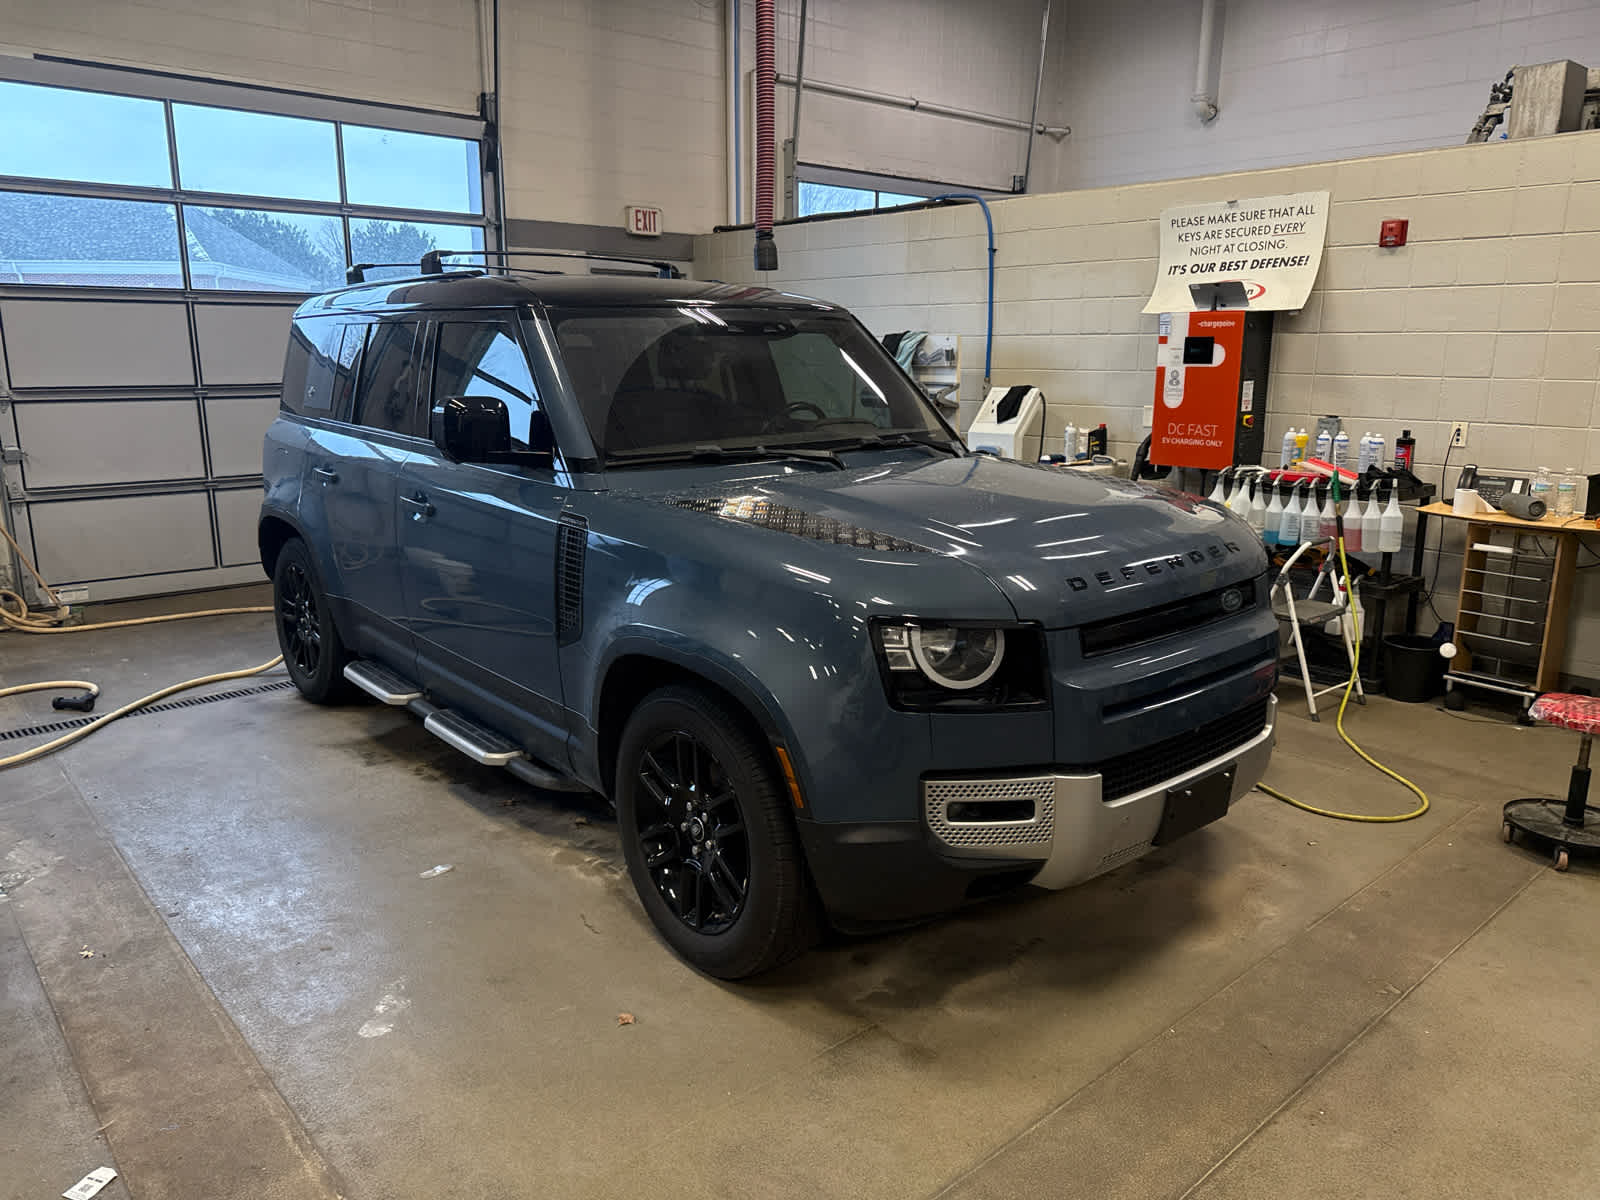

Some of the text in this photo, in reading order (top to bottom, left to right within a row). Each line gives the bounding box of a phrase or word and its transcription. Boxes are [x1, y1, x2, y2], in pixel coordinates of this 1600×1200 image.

[635, 209, 657, 232] EXIT
[1171, 204, 1315, 228] PLEASE MAKE SURE THAT ALL
[1178, 221, 1306, 243] KEYS ARE SECURED EVERY
[1190, 239, 1288, 257] NIGHT AT CLOSING.
[1168, 255, 1310, 276] IT'S OUR BEST DEFENSE!
[1168, 422, 1219, 438] DC FAST
[1171, 438, 1205, 446] CHARGING
[1065, 541, 1241, 592] DEFENDER
